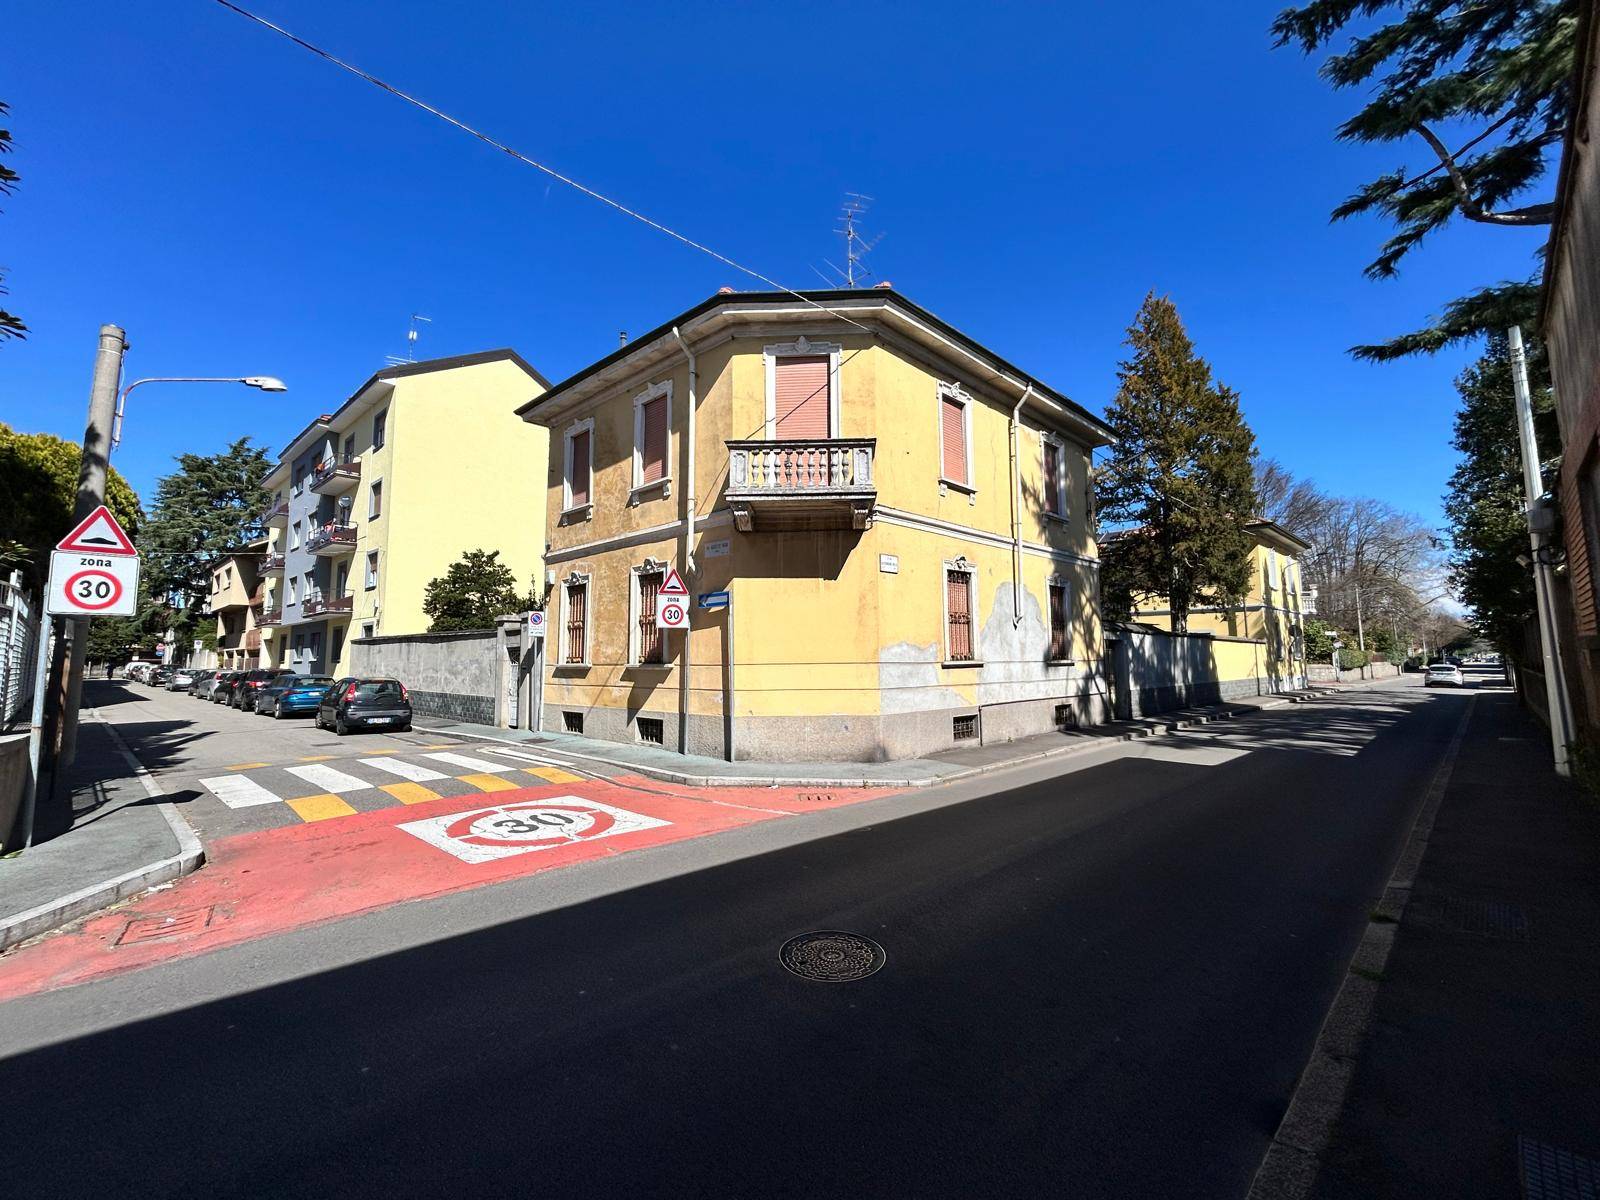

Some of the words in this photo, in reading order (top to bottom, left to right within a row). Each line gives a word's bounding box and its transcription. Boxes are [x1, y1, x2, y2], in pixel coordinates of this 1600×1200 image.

[80, 558, 112, 567] zona
[78, 580, 111, 599] 30
[667, 609, 680, 620] 30
[492, 812, 575, 834] 30
